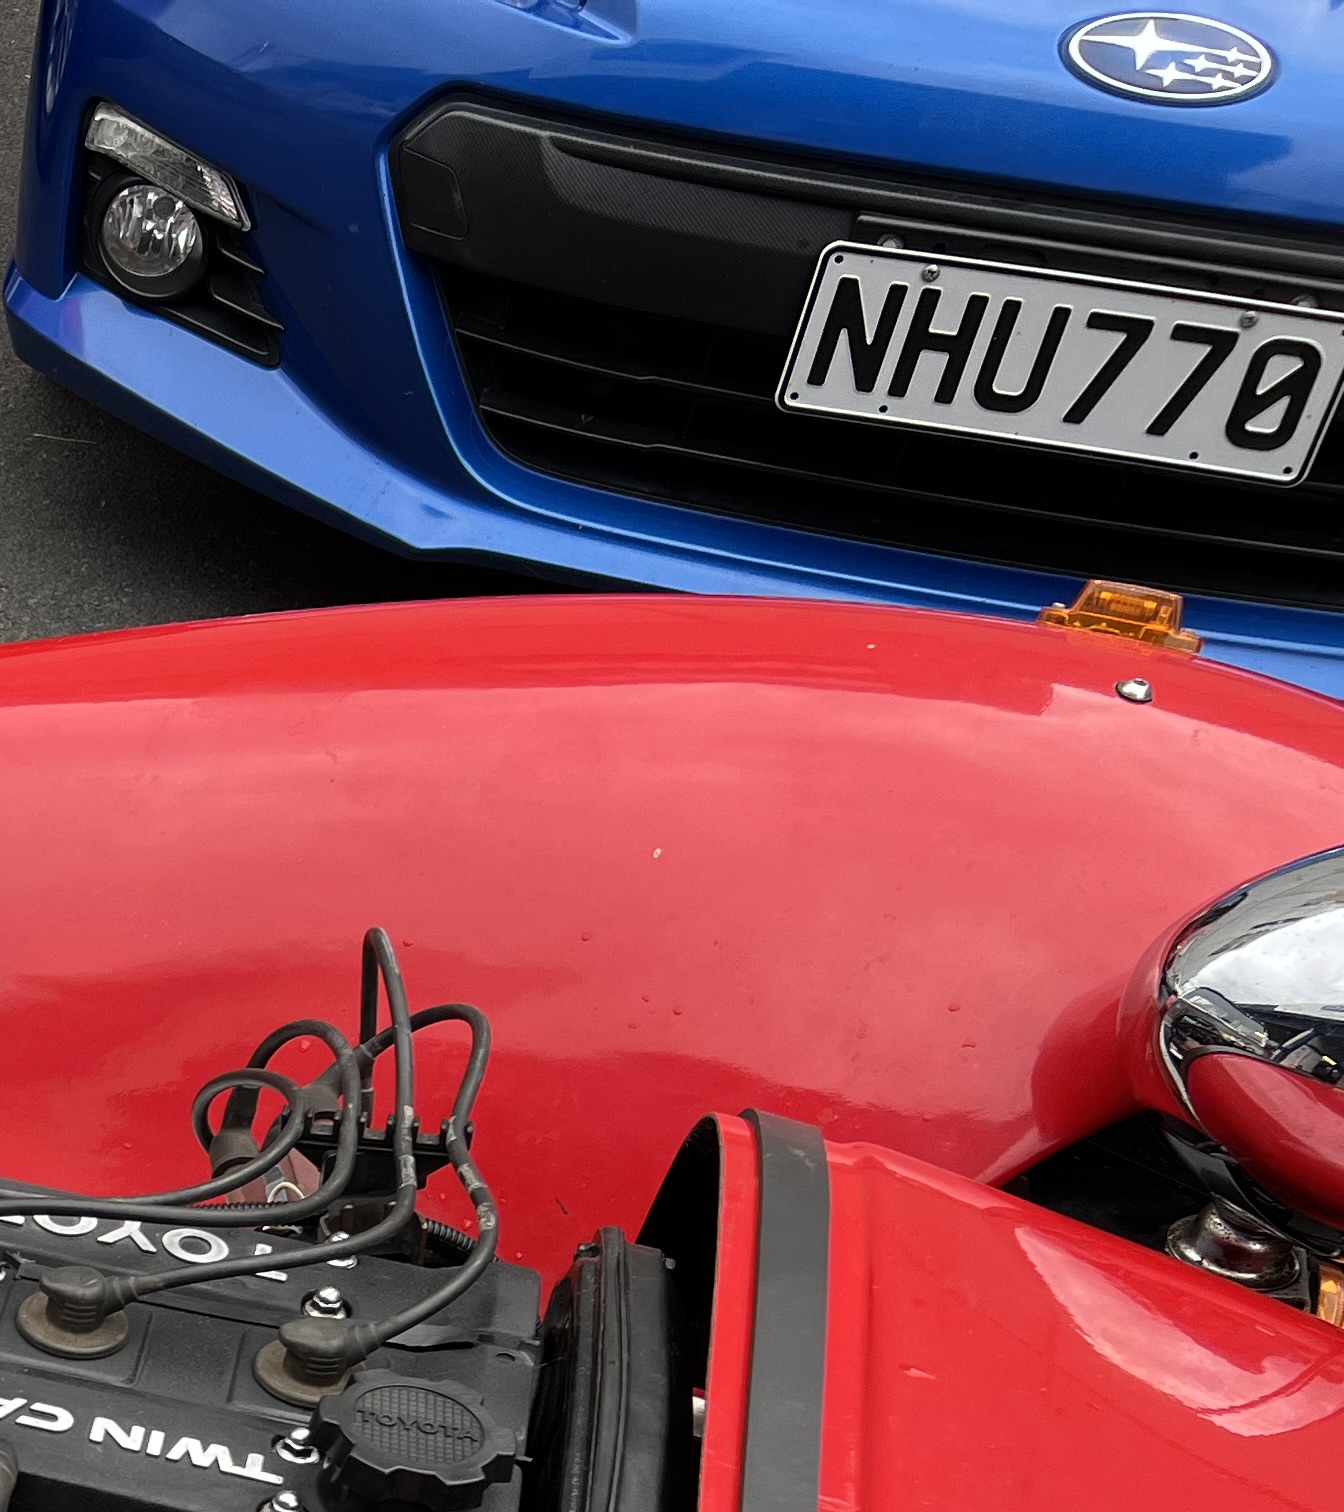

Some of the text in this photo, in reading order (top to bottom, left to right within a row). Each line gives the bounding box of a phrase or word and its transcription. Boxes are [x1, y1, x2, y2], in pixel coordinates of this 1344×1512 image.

[806, 274, 1325, 452] NHU770
[88, 1416, 284, 1485] TWIN
[355, 1408, 479, 1443] TOYOTA
